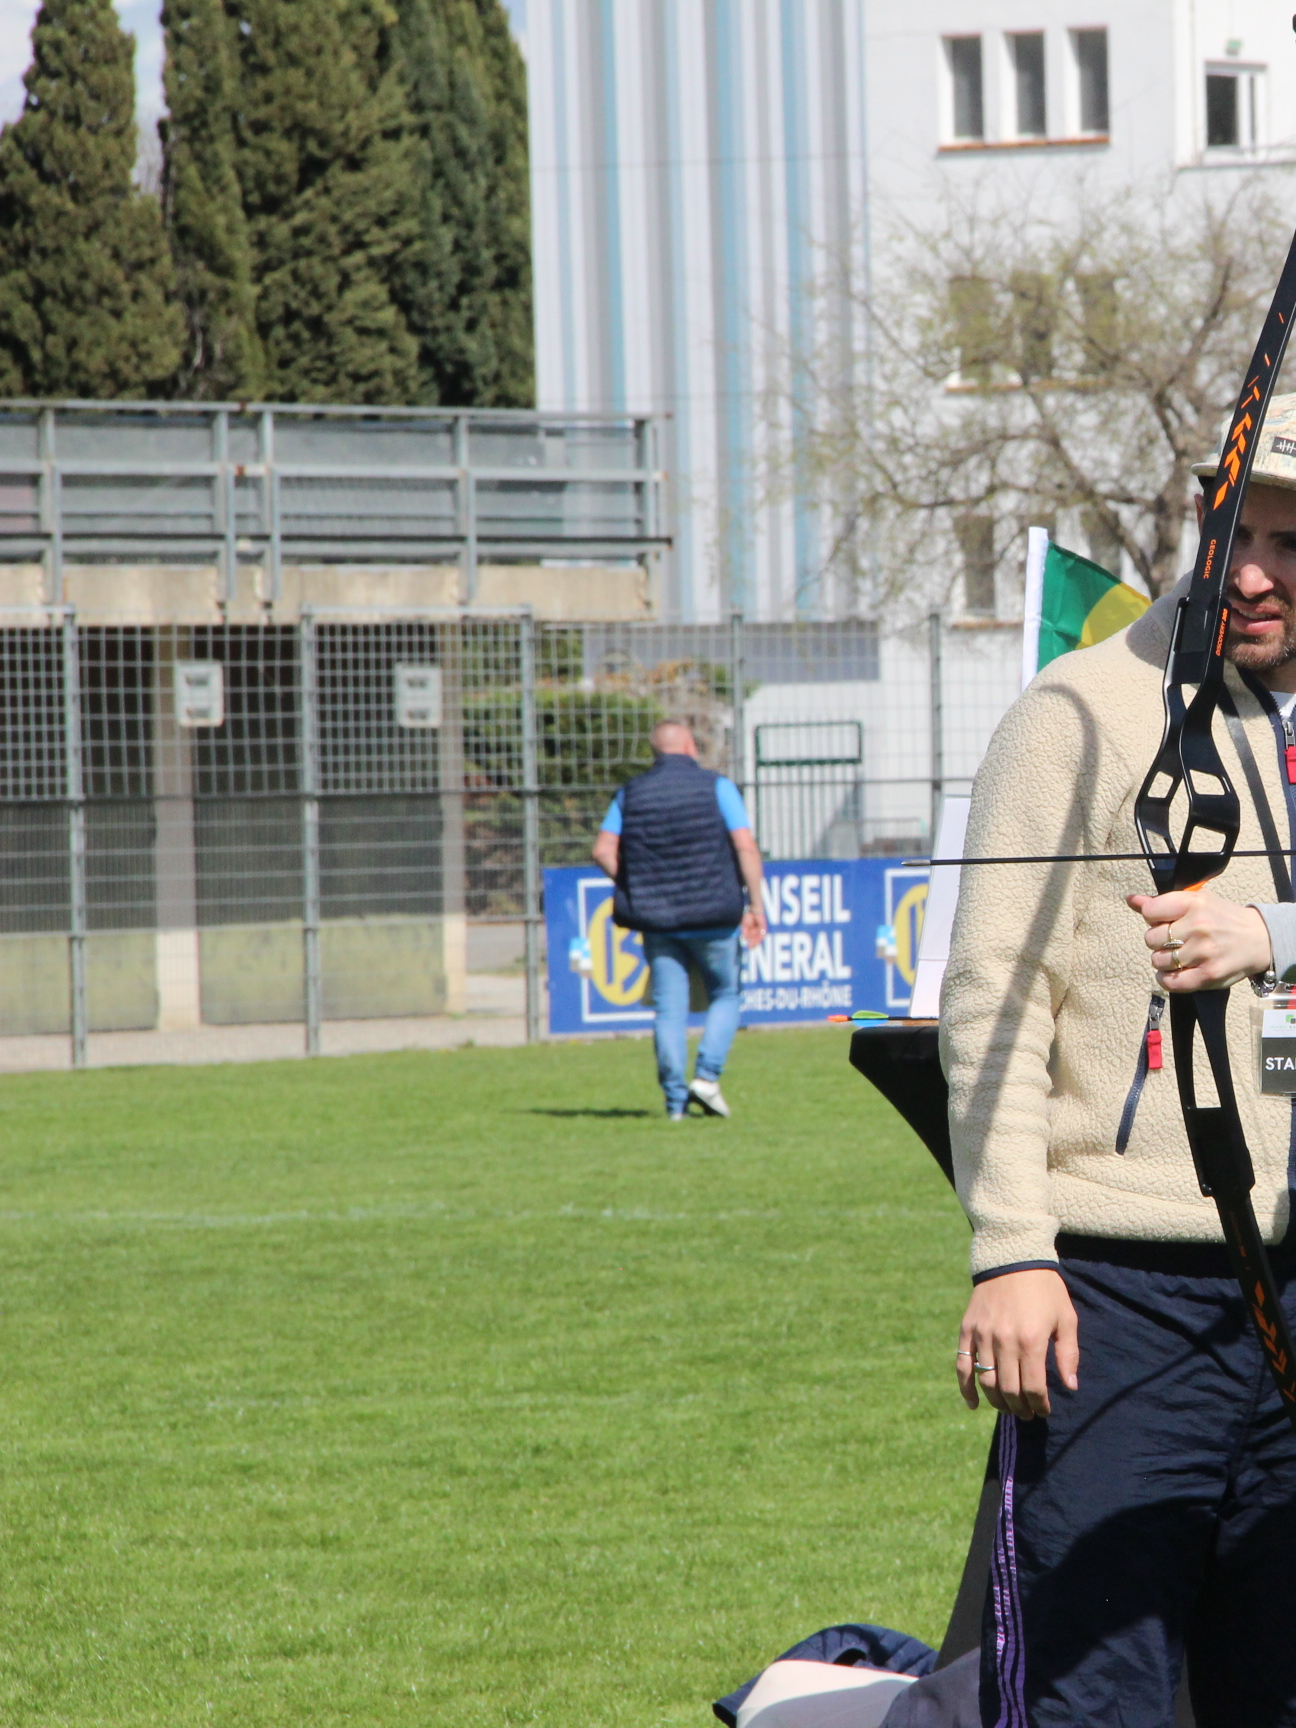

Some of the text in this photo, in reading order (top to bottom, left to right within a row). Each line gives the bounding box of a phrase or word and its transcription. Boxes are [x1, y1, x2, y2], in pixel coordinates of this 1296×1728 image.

[1203, 539, 1217, 579] GEOLOGIC
[1215, 620, 1226, 657] DISCOVERY
[760, 873, 851, 926] NSEIL
